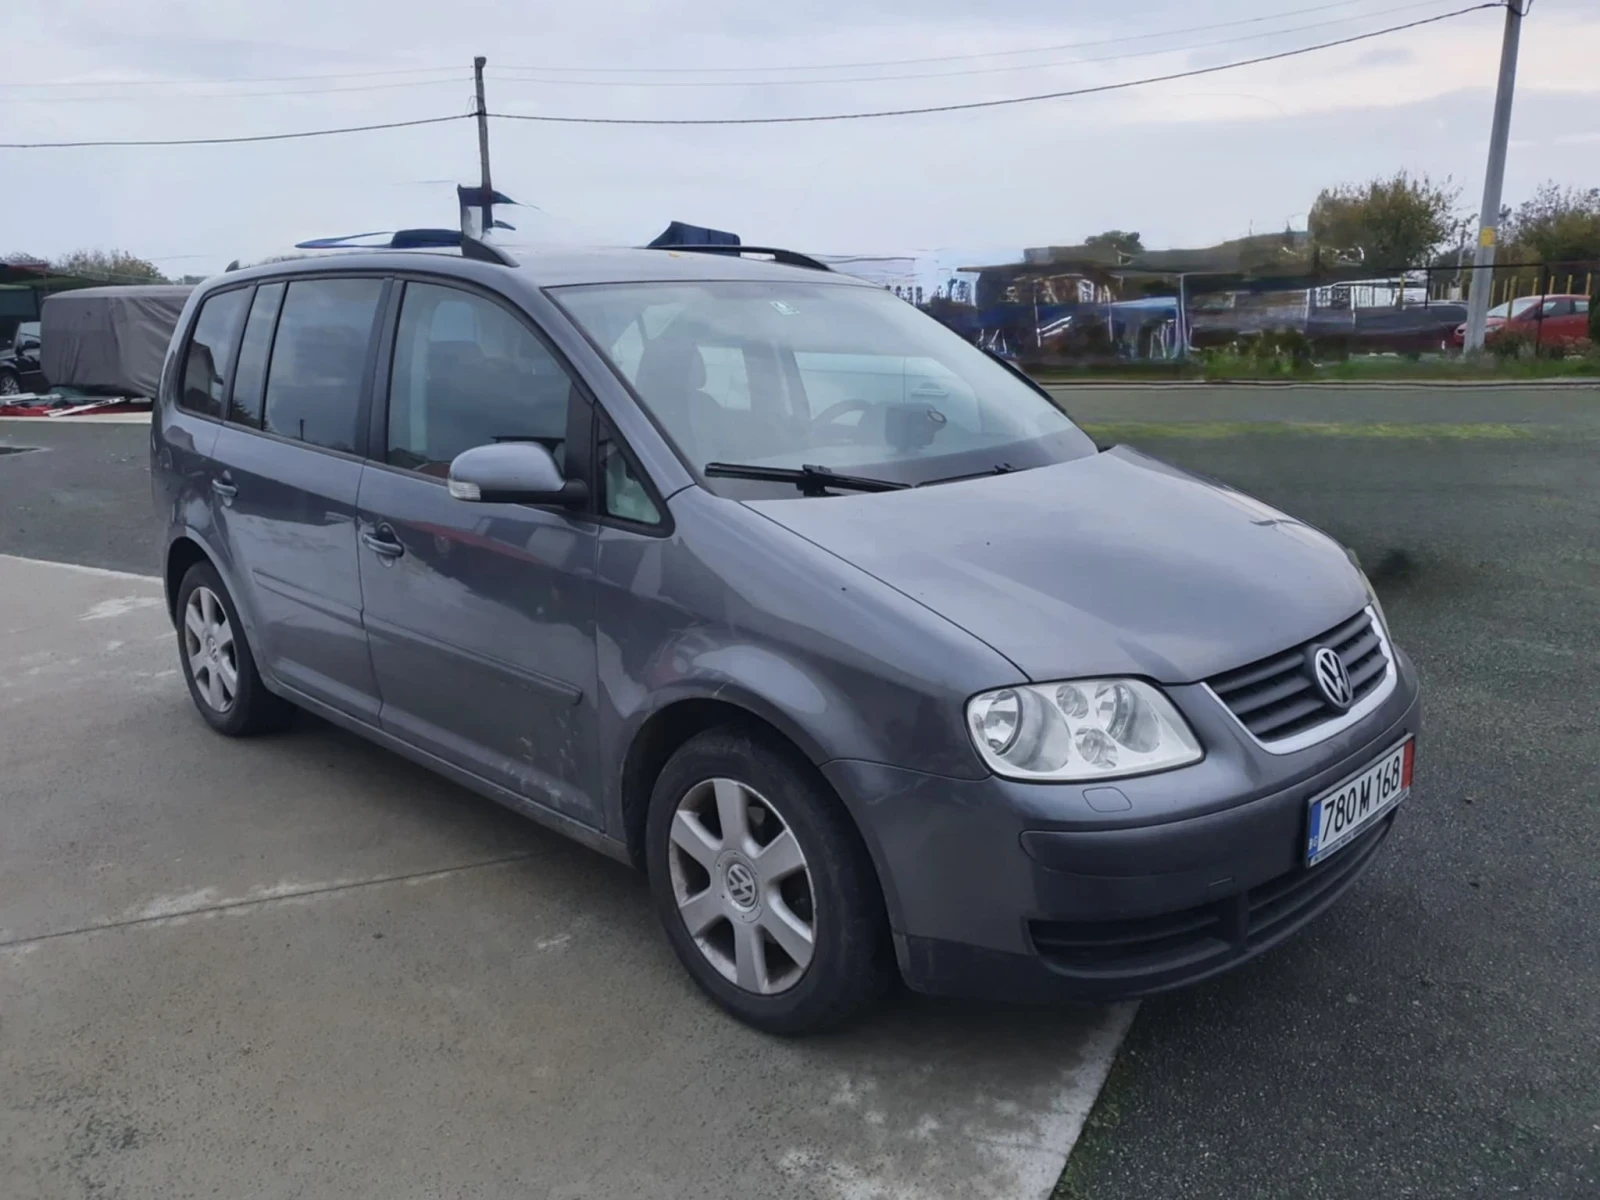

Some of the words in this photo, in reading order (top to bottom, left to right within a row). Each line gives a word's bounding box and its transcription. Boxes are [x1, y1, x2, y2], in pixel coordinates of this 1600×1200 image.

[1322, 786, 1356, 843] 780
[1358, 775, 1372, 818] M
[1376, 755, 1400, 805] 168
